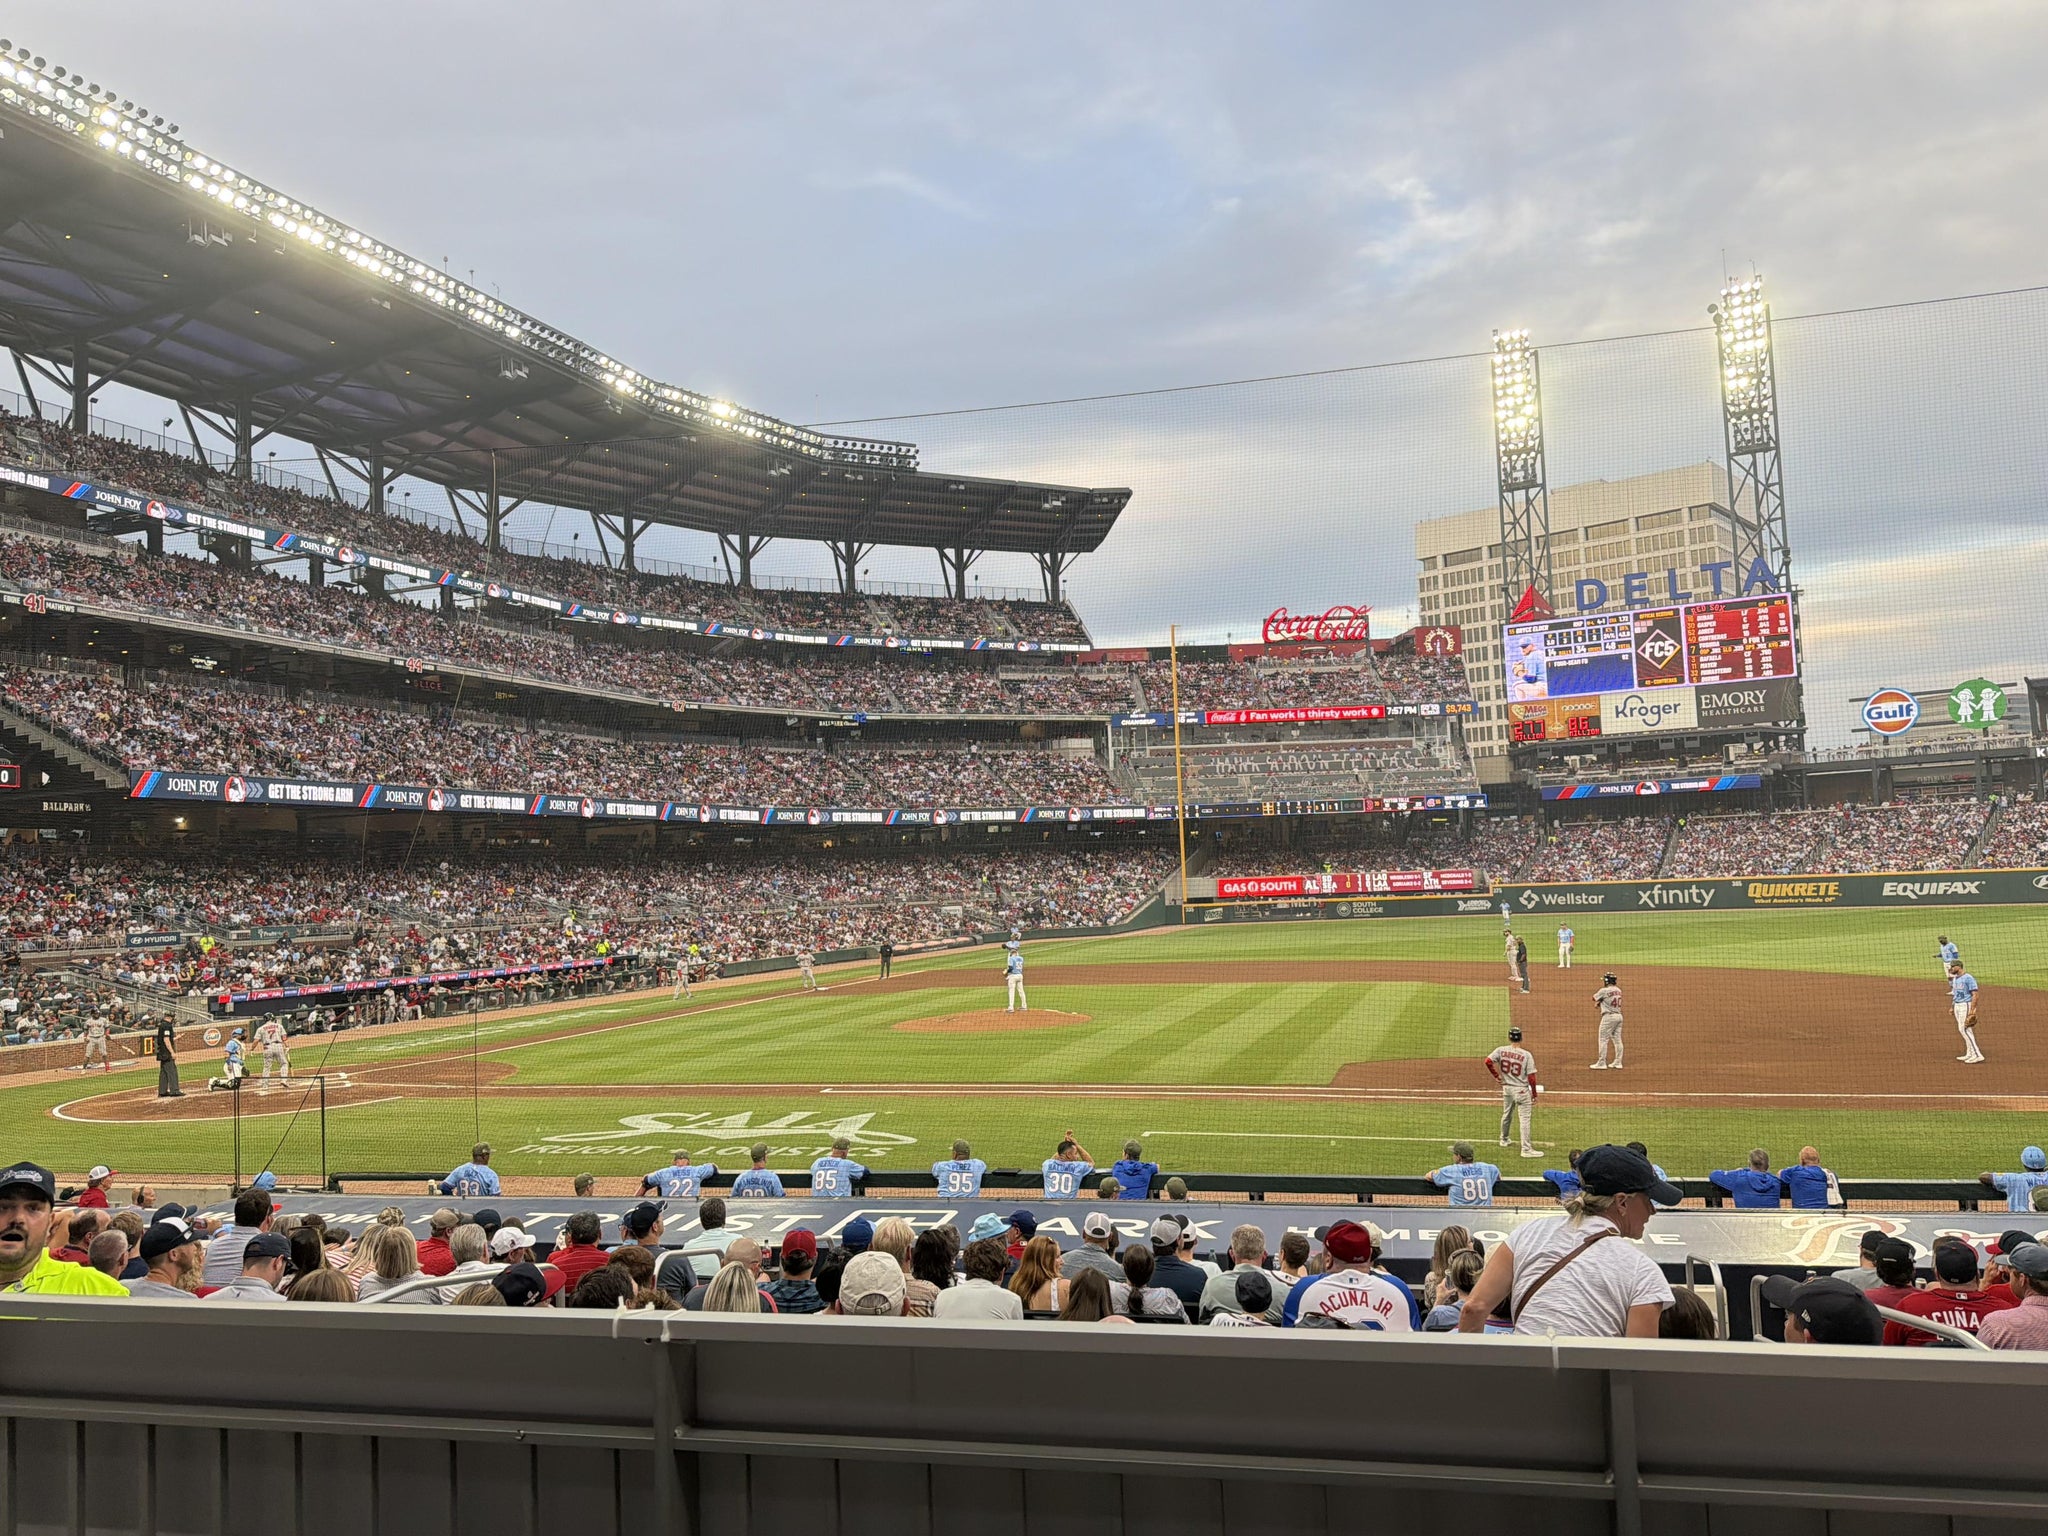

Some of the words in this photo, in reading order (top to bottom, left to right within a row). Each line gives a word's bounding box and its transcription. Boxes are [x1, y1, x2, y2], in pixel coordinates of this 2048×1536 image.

[26, 474, 49, 490] ARM
[95, 491, 121, 504] JOHN
[124, 498, 142, 511] FOY
[186, 512, 201, 526] GET
[202, 515, 217, 529] THE
[217, 520, 248, 537] STRONG
[249, 527, 265, 541] ARM
[300, 540, 320, 552] JOHN
[321, 544, 336, 556] FOY
[1575, 557, 1780, 611] DELTA
[23, 592, 46, 614] 41
[46, 601, 75, 613] MATHEWS
[1709, 604, 1726, 612] SOX
[1261, 605, 1374, 643] Coca-Cola
[1605, 642, 1616, 650] 48
[1645, 640, 1675, 658] FC5
[1690, 645, 1697, 654] 7
[406, 656, 423, 674] 44
[1701, 689, 1767, 709] EMORY
[671, 700, 686, 712] 47
[1386, 706, 1404, 716] 7:57
[1404, 706, 1417, 715] PM
[1525, 705, 1547, 713] MEGA
[1615, 694, 1681, 727] Kroger
[1702, 705, 1765, 717] HEALTHCARE
[1866, 703, 1914, 720] Gulf
[854, 712, 868, 724] 42
[1251, 712, 1271, 721] Fan
[1272, 710, 1296, 720] work
[1297, 709, 1306, 719] is
[1307, 708, 1346, 720] thirsty
[1347, 709, 1368, 718] work
[1514, 719, 1545, 735] 277
[1569, 728, 1600, 737] MILLION
[1515, 733, 1545, 741] MILLION
[1269, 754, 1329, 770] AARON
[1331, 750, 1422, 768] TERRACE
[167, 778, 195, 792] JOHN
[198, 780, 219, 793] FOY
[1618, 784, 1634, 793] FOY
[268, 783, 284, 799] GET
[284, 784, 301, 800] THE
[301, 785, 334, 802] STRONG
[335, 787, 353, 803] ARM
[385, 790, 408, 803] JOHN
[409, 792, 424, 804] FOY
[42, 801, 84, 812] BALLPARK
[460, 795, 473, 808] GET
[473, 795, 486, 808] THE
[486, 796, 511, 810] STRONG
[550, 799, 566, 810] JOHN
[567, 800, 579, 811] FOY
[606, 803, 617, 815] GET
[675, 807, 688, 816] JOHN
[688, 808, 699, 817] FOY
[777, 811, 791, 820] JOHN
[793, 812, 805, 821] FOY
[901, 812, 917, 822] JOHN
[918, 812, 930, 822] FOY
[982, 810, 1003, 821] STRONG
[1038, 811, 1052, 819] JOHN
[1053, 810, 1066, 819] FOY
[1223, 882, 1246, 893] GAS
[1260, 880, 1297, 891] SOUTH
[1304, 880, 1319, 890] AL
[1748, 882, 1840, 898] QUIKRETE
[1883, 882, 1980, 899] EQUIFAX
[1542, 893, 1604, 905] Wellstar
[1638, 884, 1716, 908] xfinity
[144, 935, 177, 944] HYUNDAI
[205, 1033, 220, 1041] Gulf
[267, 1029, 275, 1040] 7
[1500, 1051, 1525, 1062] CABRERA
[1500, 1059, 1523, 1077] 83
[612, 1111, 884, 1142] SAIA
[508, 1144, 654, 1155] FREIGHT
[818, 1159, 840, 1167] HEFNER
[951, 1163, 972, 1171] PEREZ
[1048, 1163, 1076, 1174] BALDWIN
[672, 1169, 691, 1178] WEISS
[815, 1169, 838, 1191] 85
[459, 1179, 480, 1196] 83
[668, 1178, 694, 1197] 22
[949, 1172, 973, 1194] 95
[1048, 1173, 1073, 1194] 30
[1461, 1178, 1489, 1201] 80
[1372, 1296, 1394, 1321] JR.
